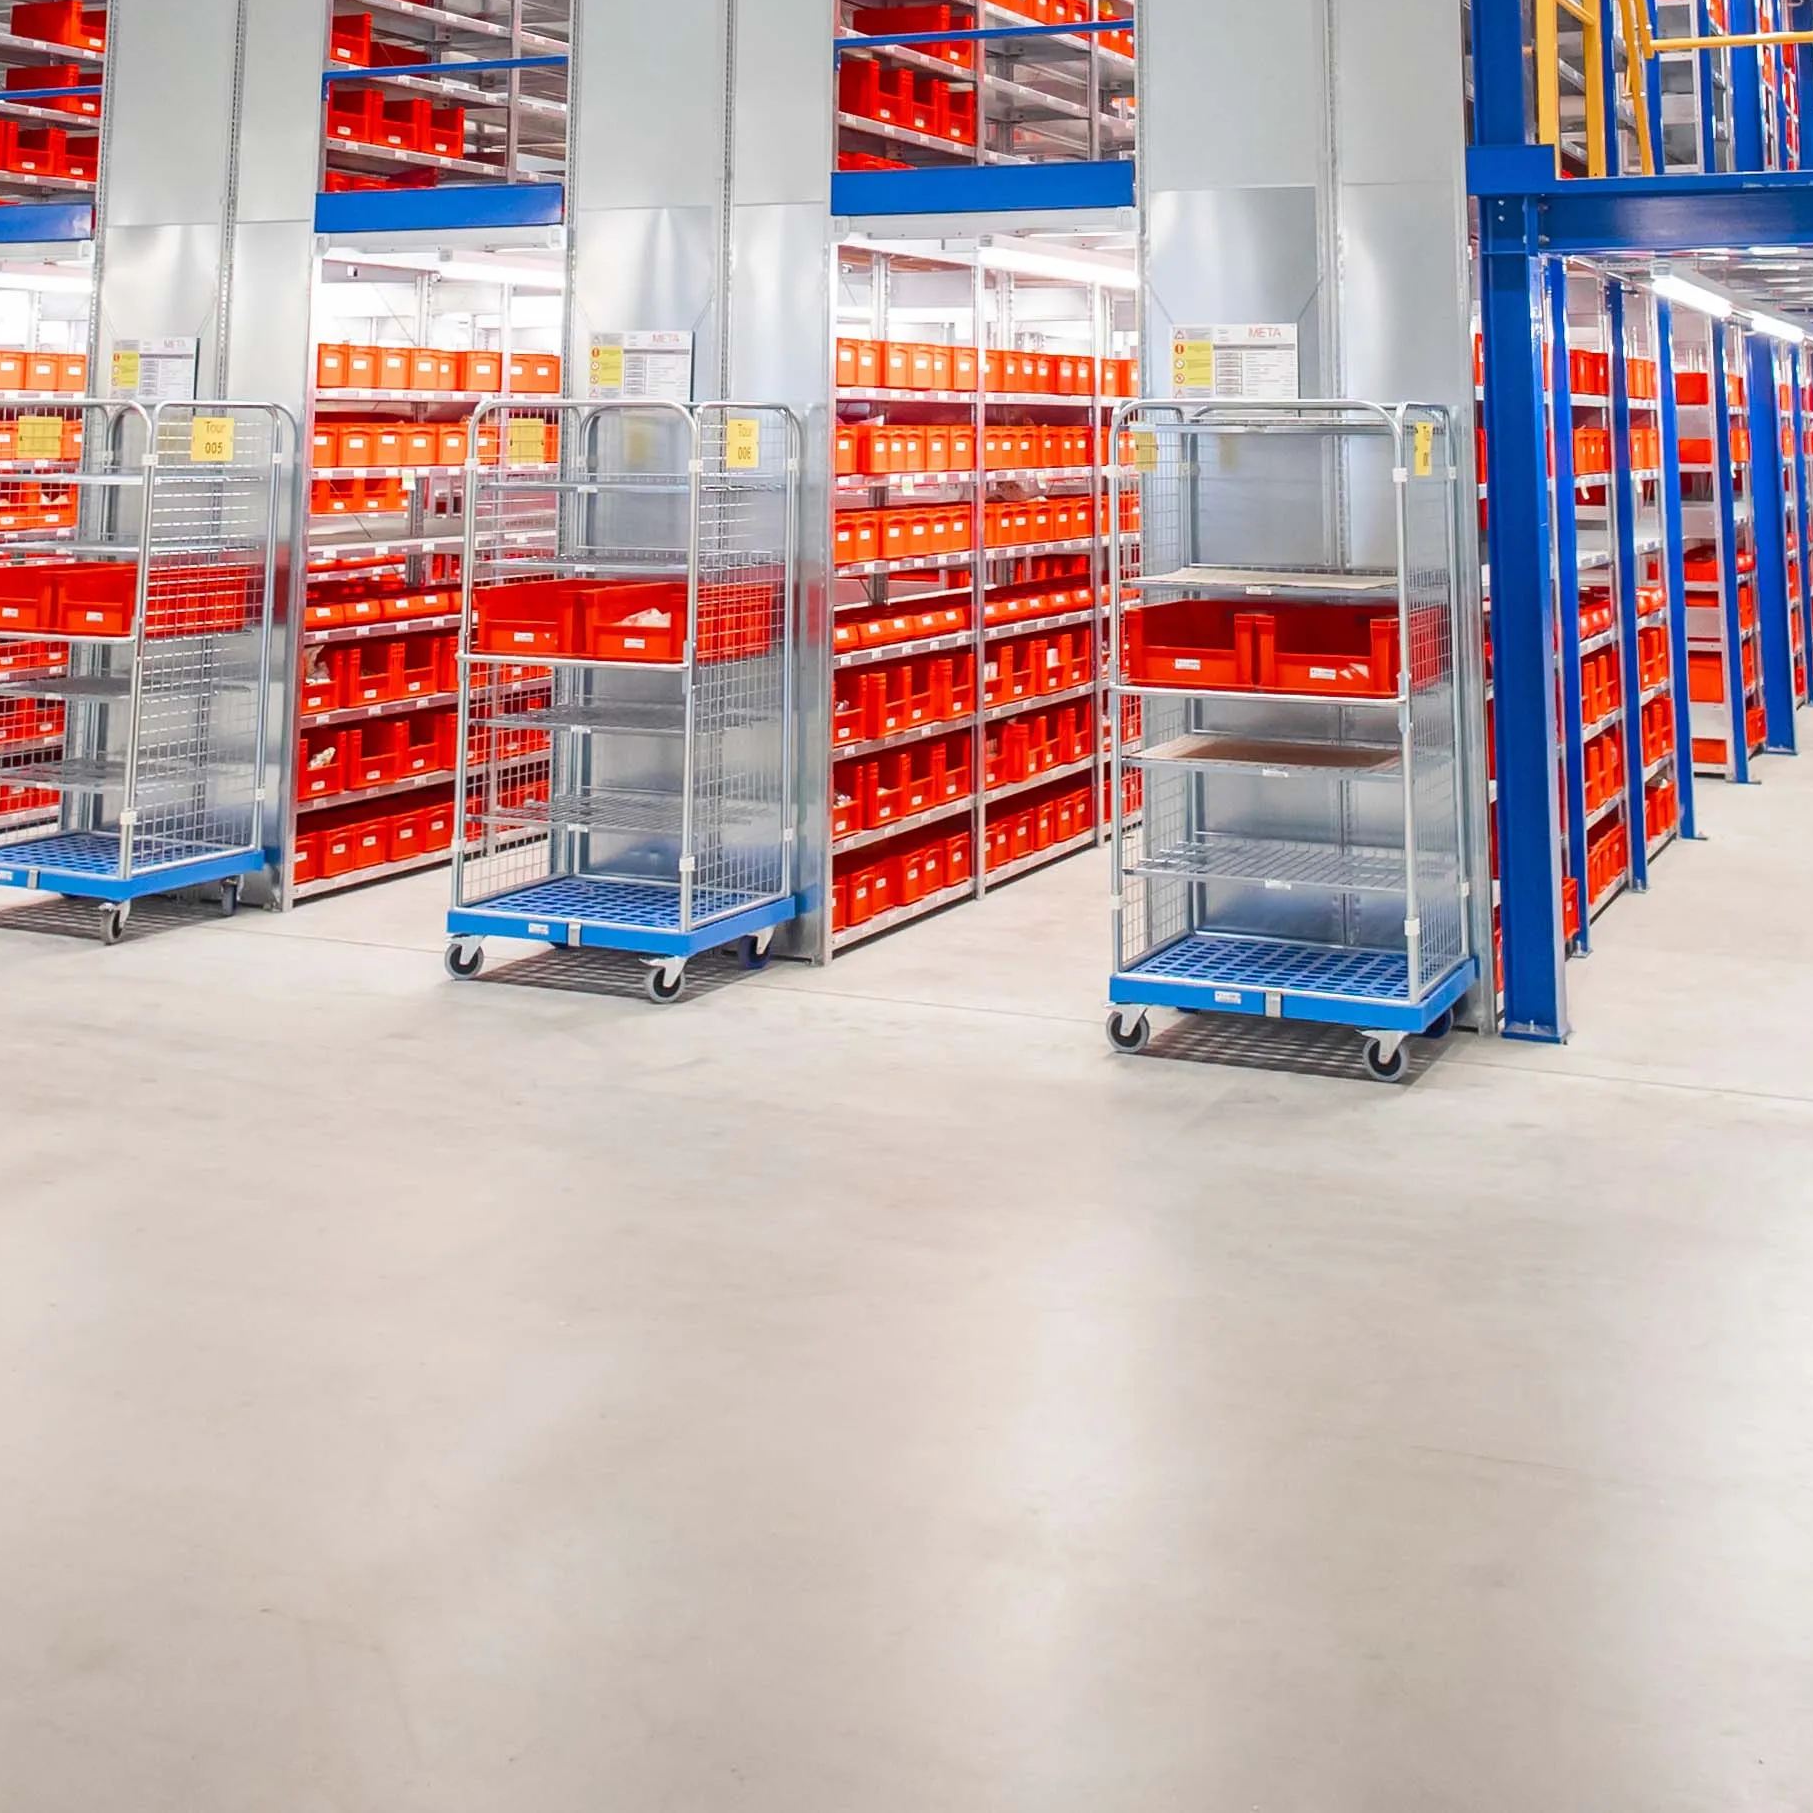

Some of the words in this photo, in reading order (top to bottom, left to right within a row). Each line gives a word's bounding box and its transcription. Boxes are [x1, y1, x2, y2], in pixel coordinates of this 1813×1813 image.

[1247, 327, 1282, 338] META
[204, 420, 227, 434] Tour
[204, 441, 223, 455] 005
